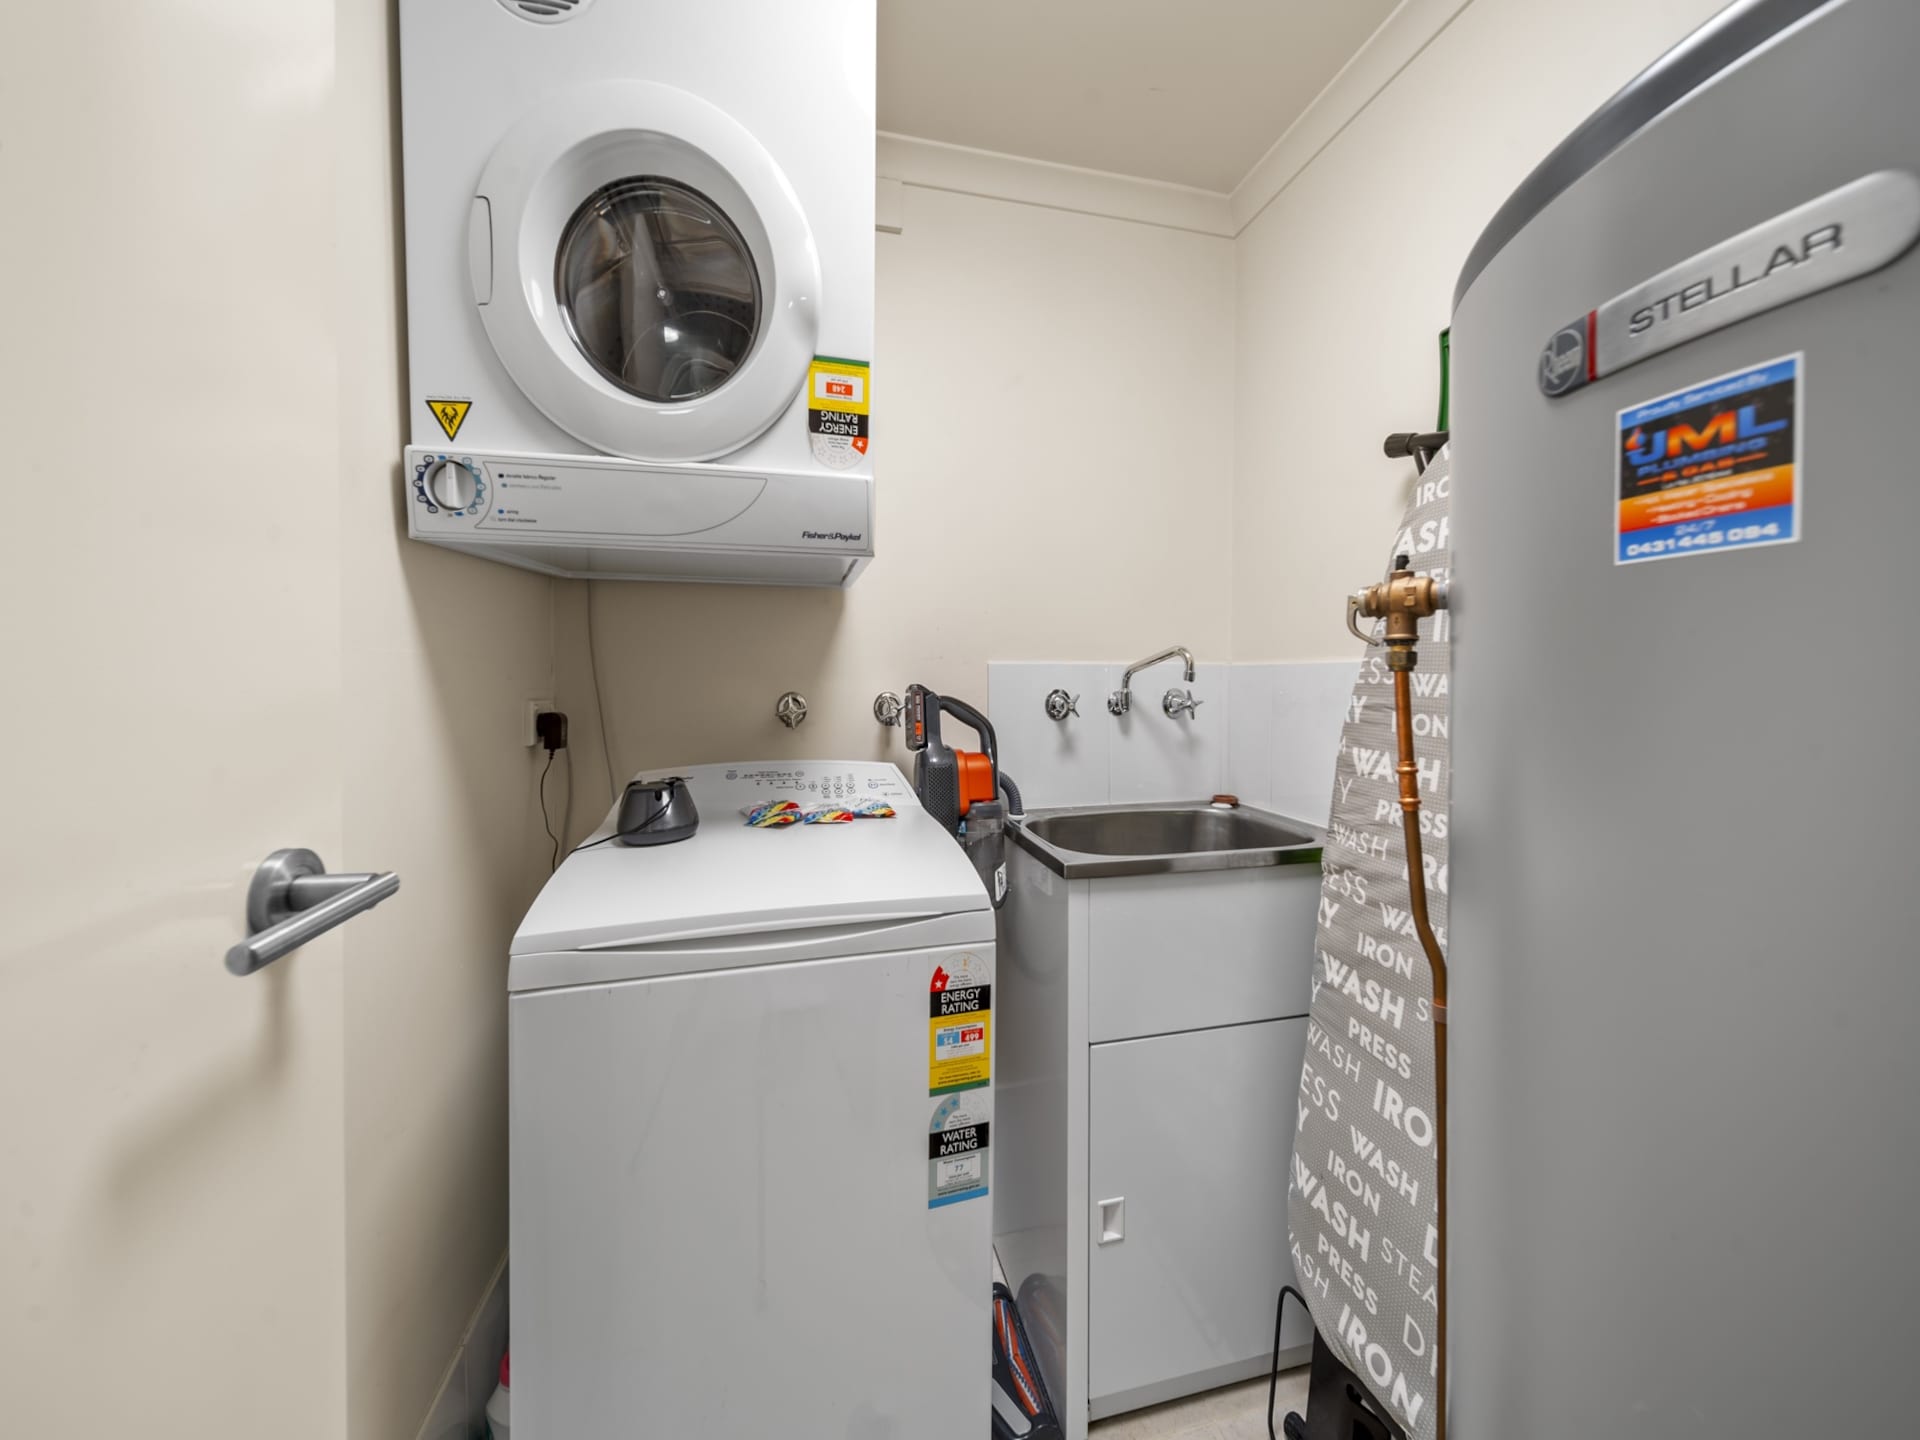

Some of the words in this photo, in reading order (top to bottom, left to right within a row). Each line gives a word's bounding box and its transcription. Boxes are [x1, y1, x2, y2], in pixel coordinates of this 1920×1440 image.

[1630, 222, 1843, 337] STELLAR
[819, 421, 858, 436] ENERGY
[821, 410, 858, 424] RATING
[1625, 405, 1788, 465] JML
[1637, 437, 1767, 476] PLUMBING
[1682, 457, 1734, 477] GAS
[1626, 537, 1676, 556] 0431
[1677, 530, 1724, 550] 445
[1391, 710, 1448, 739] ION
[1352, 746, 1440, 793] WAH
[1376, 798, 1448, 839] PRSS
[1357, 931, 1414, 980] IRON
[941, 988, 981, 1003] ENERGY
[941, 1000, 980, 1015] RATING
[1321, 949, 1405, 1029] WASH
[1307, 1022, 1361, 1083] WASH
[1348, 1016, 1411, 1080] PRESS
[940, 1139, 978, 1156] RATING
[942, 1127, 977, 1142] WATER
[1327, 1149, 1380, 1217] IRON
[1351, 1124, 1419, 1207] WASH
[1294, 1151, 1371, 1264] WASH
[1318, 1231, 1379, 1316] PRESS
[1338, 1302, 1425, 1428] IRON
